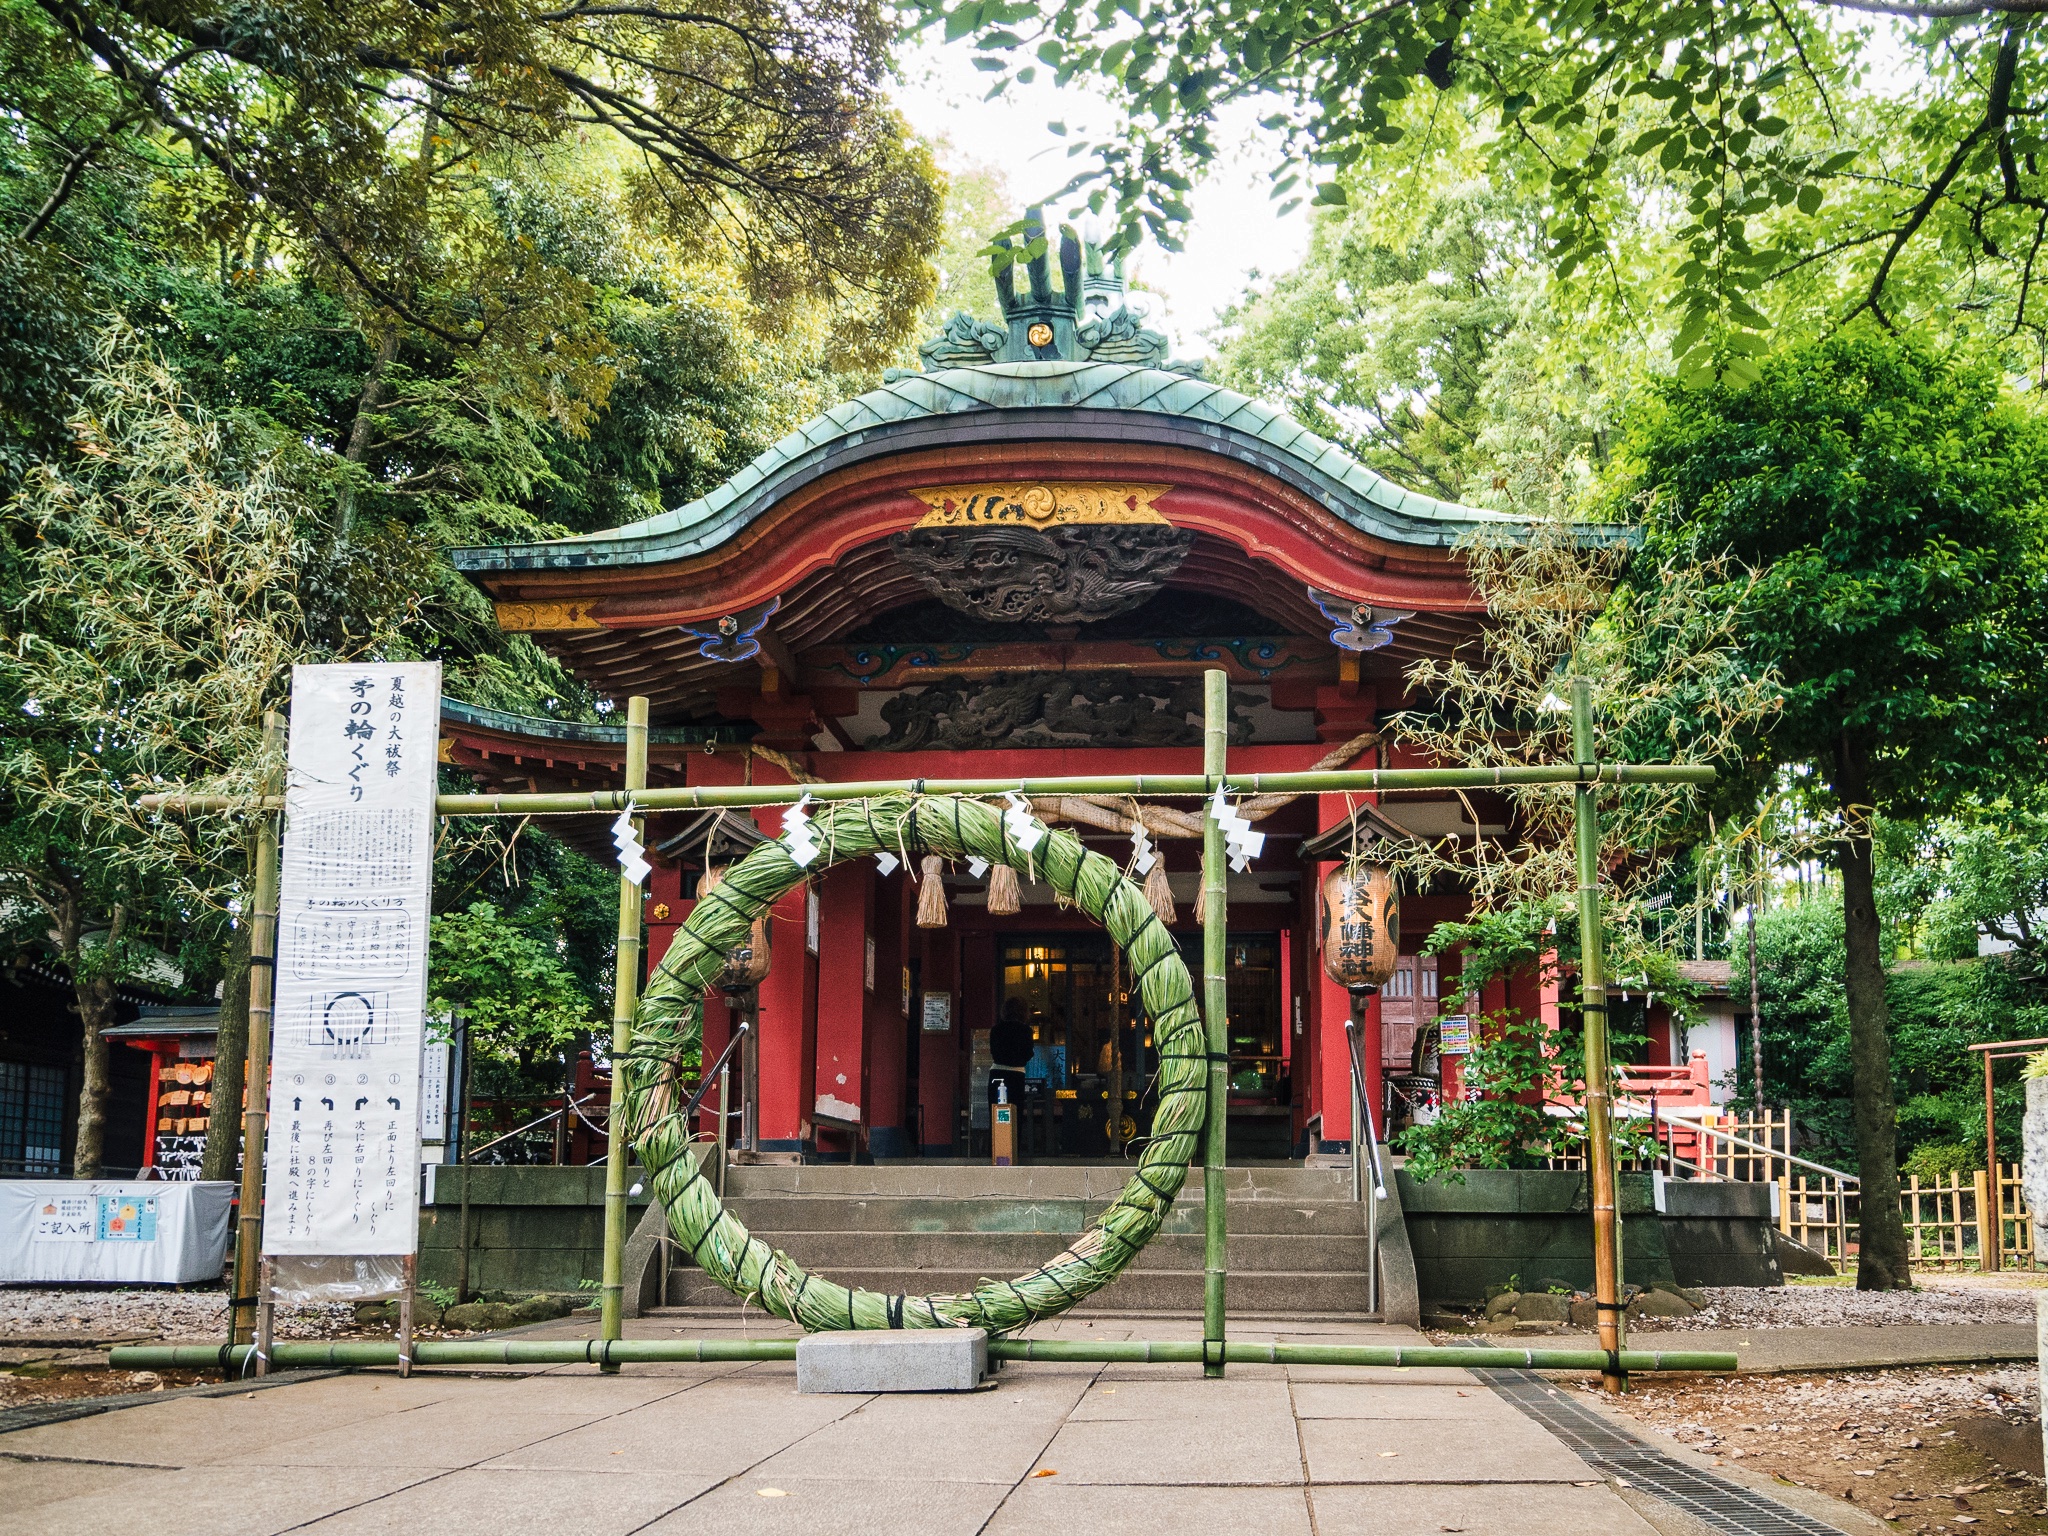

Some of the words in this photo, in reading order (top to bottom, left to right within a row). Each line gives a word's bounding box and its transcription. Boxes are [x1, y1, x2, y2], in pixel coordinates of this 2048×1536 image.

[344, 676, 377, 802] 茅の輪くぐり
[385, 676, 405, 777] 夏越の大祓祭
[307, 895, 406, 909] 茅の輪のくぐり方
[287, 1120, 302, 1236] 最後に社殿へ進みます
[304, 1156, 316, 1236] 8の字にくぐり
[322, 1120, 334, 1188] 再び左回りと
[352, 1120, 366, 1224] 次に右回りにくぐり
[384, 1120, 398, 1211] 正面より左回りに
[39, 1221, 91, 1235] ご記入所
